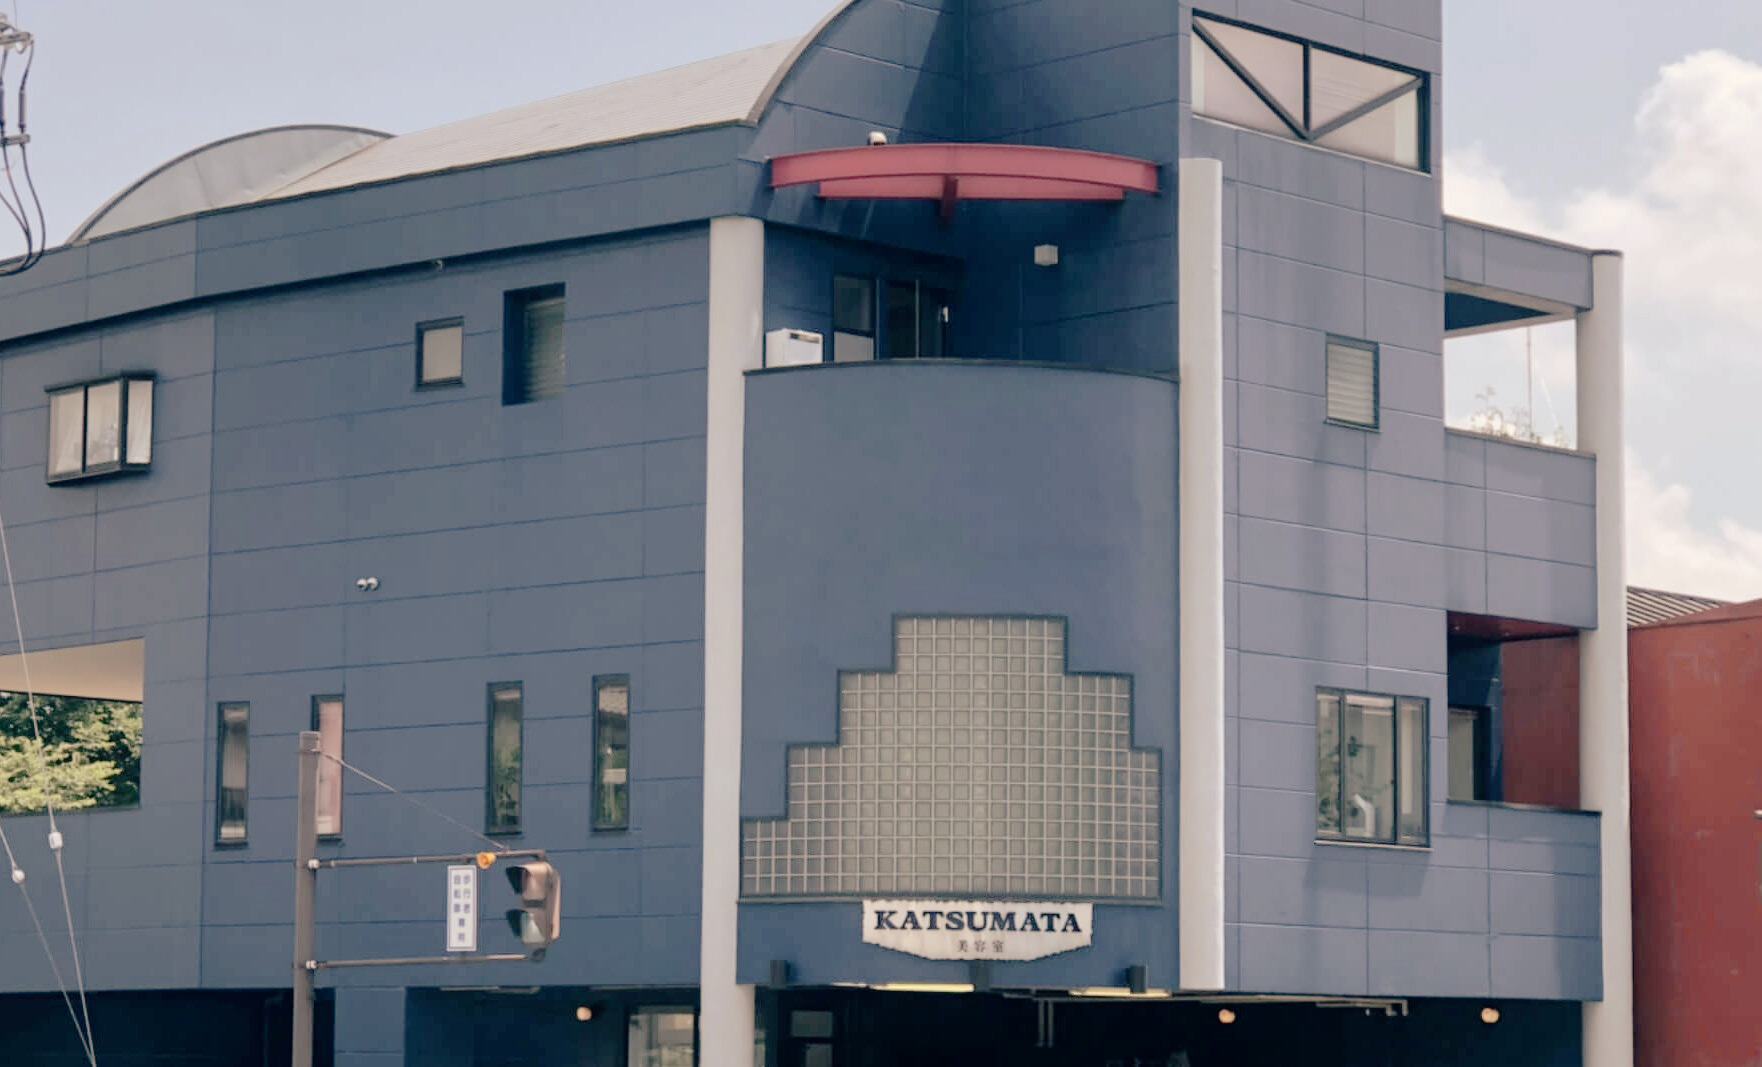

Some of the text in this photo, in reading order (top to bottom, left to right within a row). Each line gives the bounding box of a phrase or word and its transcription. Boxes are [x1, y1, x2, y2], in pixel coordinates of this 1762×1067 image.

[874, 911, 1082, 932] KATSUMATA
[957, 940, 1004, 952] 美容室
